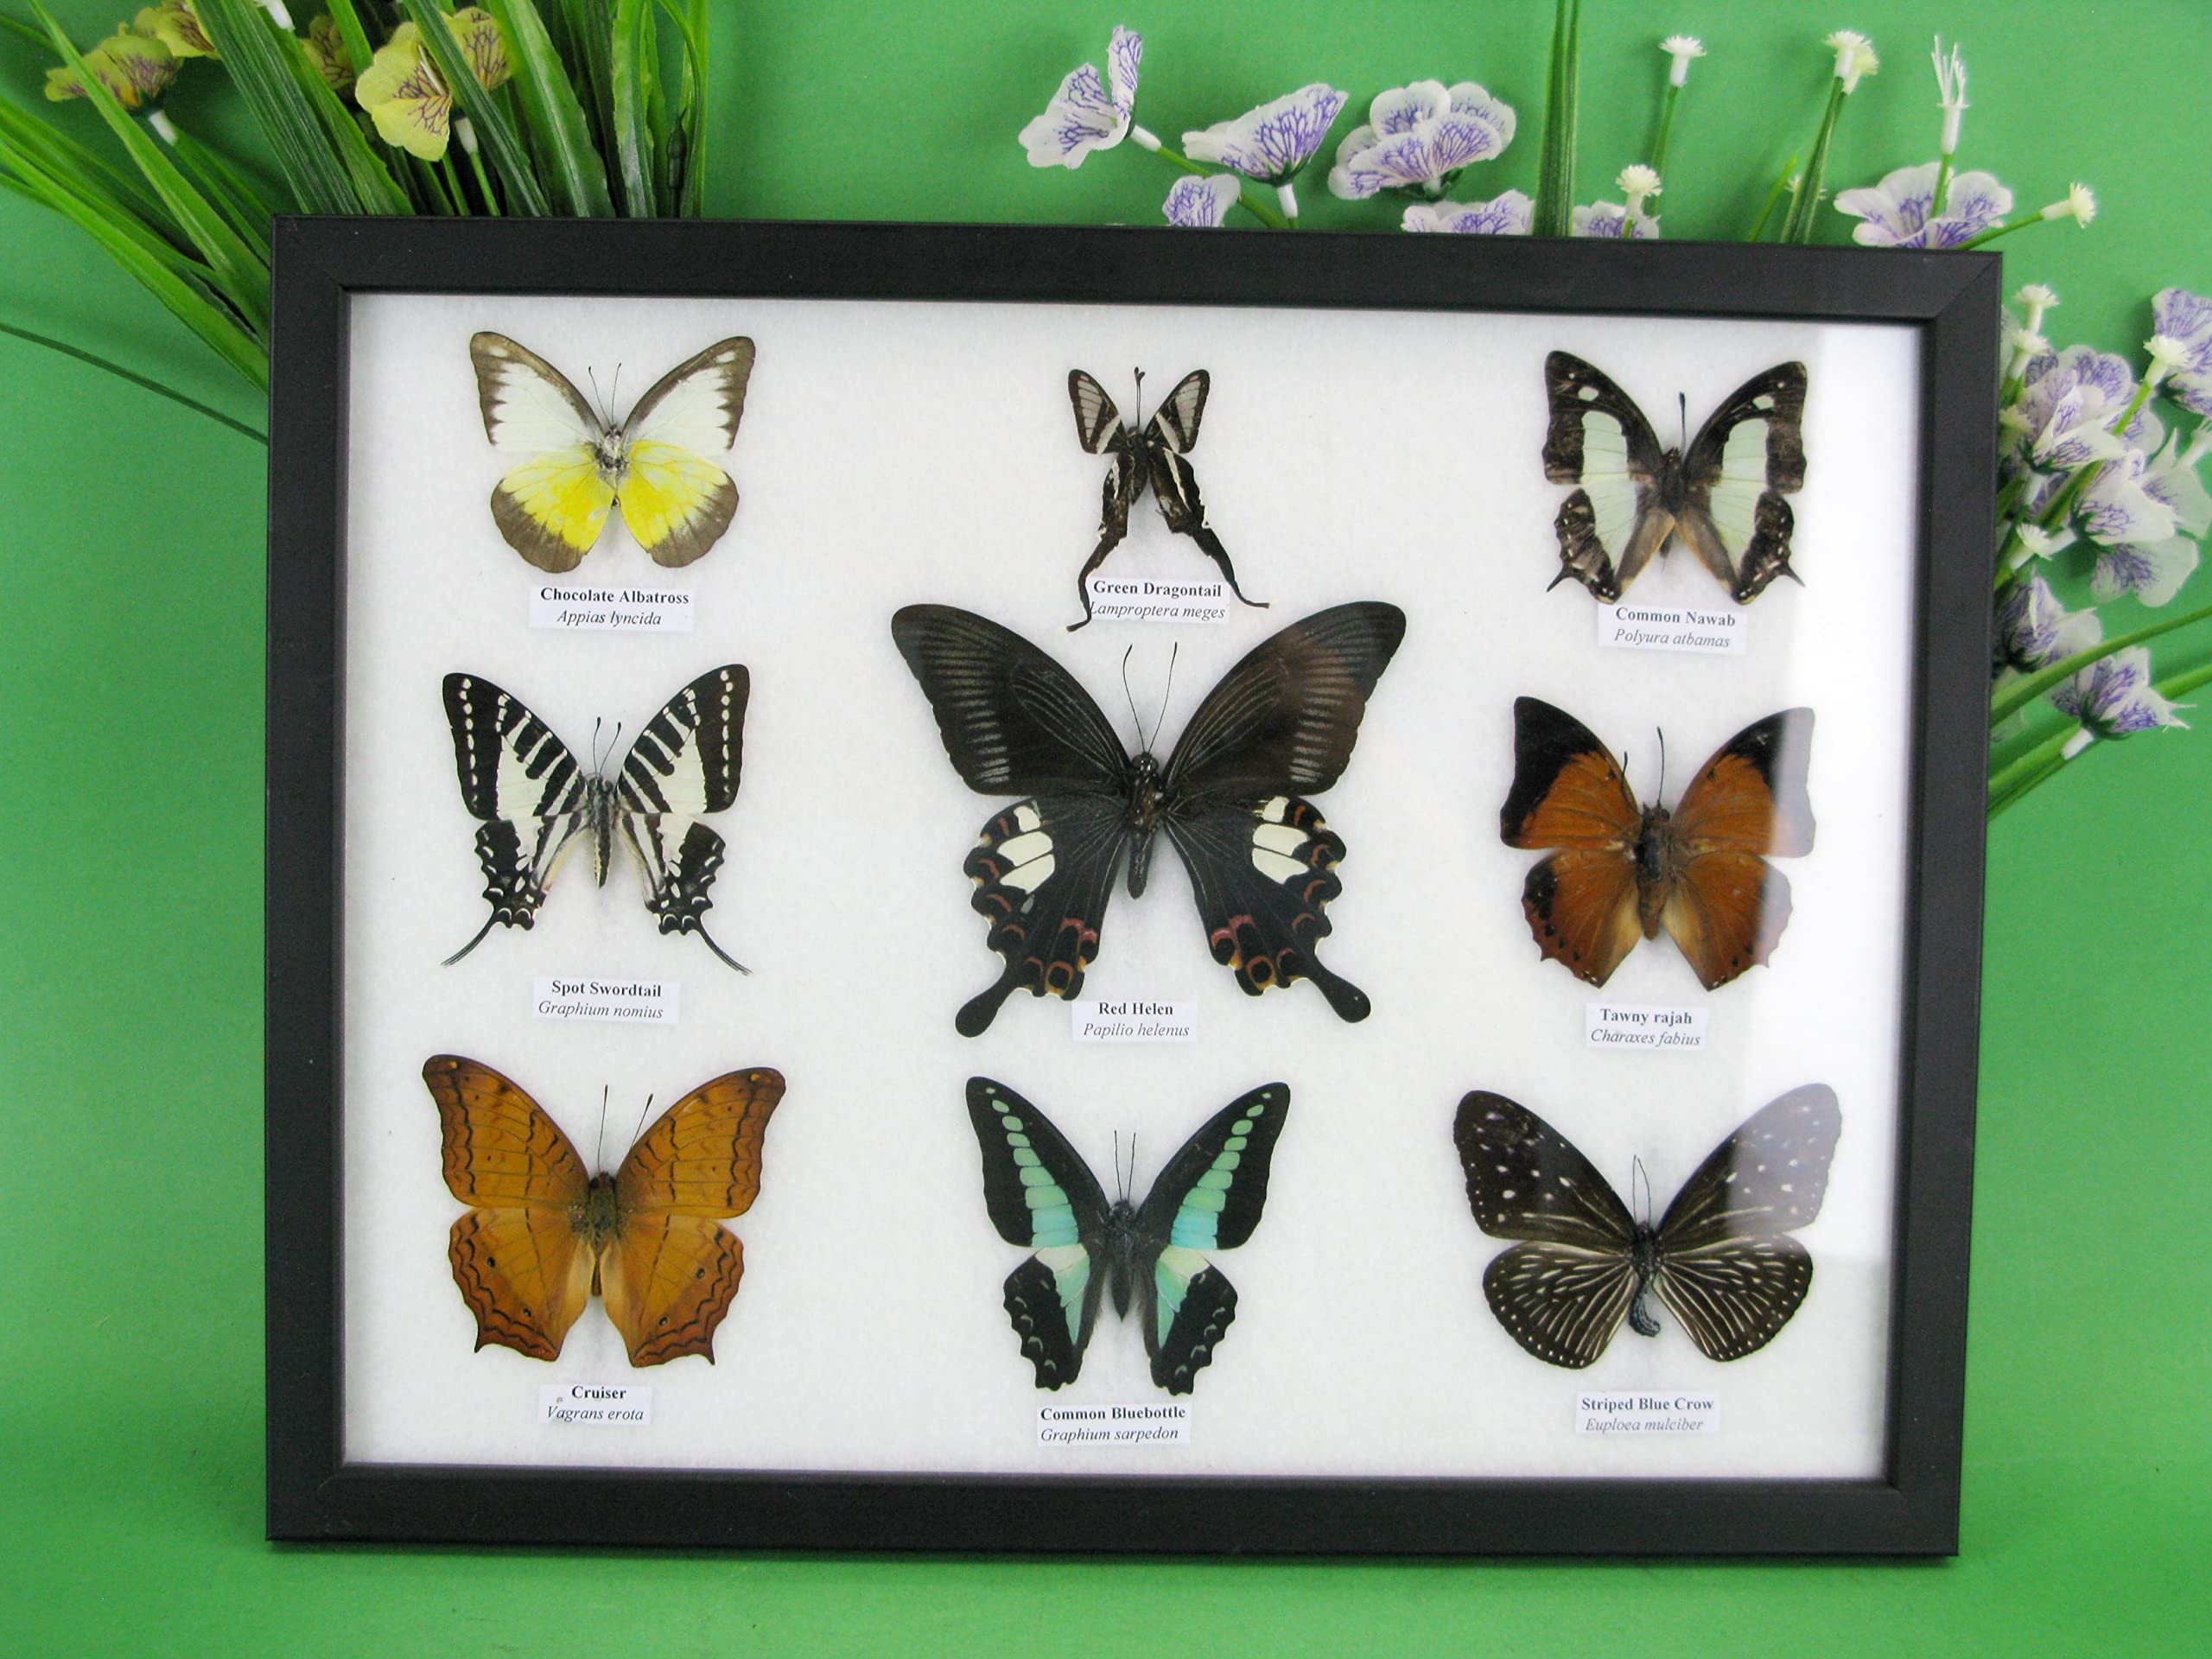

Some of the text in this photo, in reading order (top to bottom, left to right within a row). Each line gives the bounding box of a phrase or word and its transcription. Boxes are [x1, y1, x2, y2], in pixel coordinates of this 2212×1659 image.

[540, 588, 690, 604] Chocolate Albatross
[1093, 580, 1222, 599] Green Dragontail
[557, 610, 662, 627] Appias lyncida
[1090, 601, 1225, 621] Lamproptera meges
[1616, 607, 1736, 626] Common Nawab
[1614, 628, 1669, 646] Polyura
[551, 980, 661, 997] Spot Swordtail
[538, 1001, 664, 1019] Graphium nomius
[1098, 1002, 1173, 1015] Red Helen
[1600, 1008, 1693, 1027] Tawny rajah
[1084, 1022, 1190, 1039] Papilio helenus
[1591, 1028, 1700, 1047] Charaxes fabius
[571, 1385, 626, 1399] Cruiser
[547, 1406, 645, 1422] Vagrans erota
[1040, 1406, 1186, 1421] Common Bluebottle
[1581, 1397, 1714, 1414] Striped Blue Crow
[1586, 1418, 1703, 1433] Euploea mulciber
[1040, 1426, 1179, 1444] Graphium sarpedon
